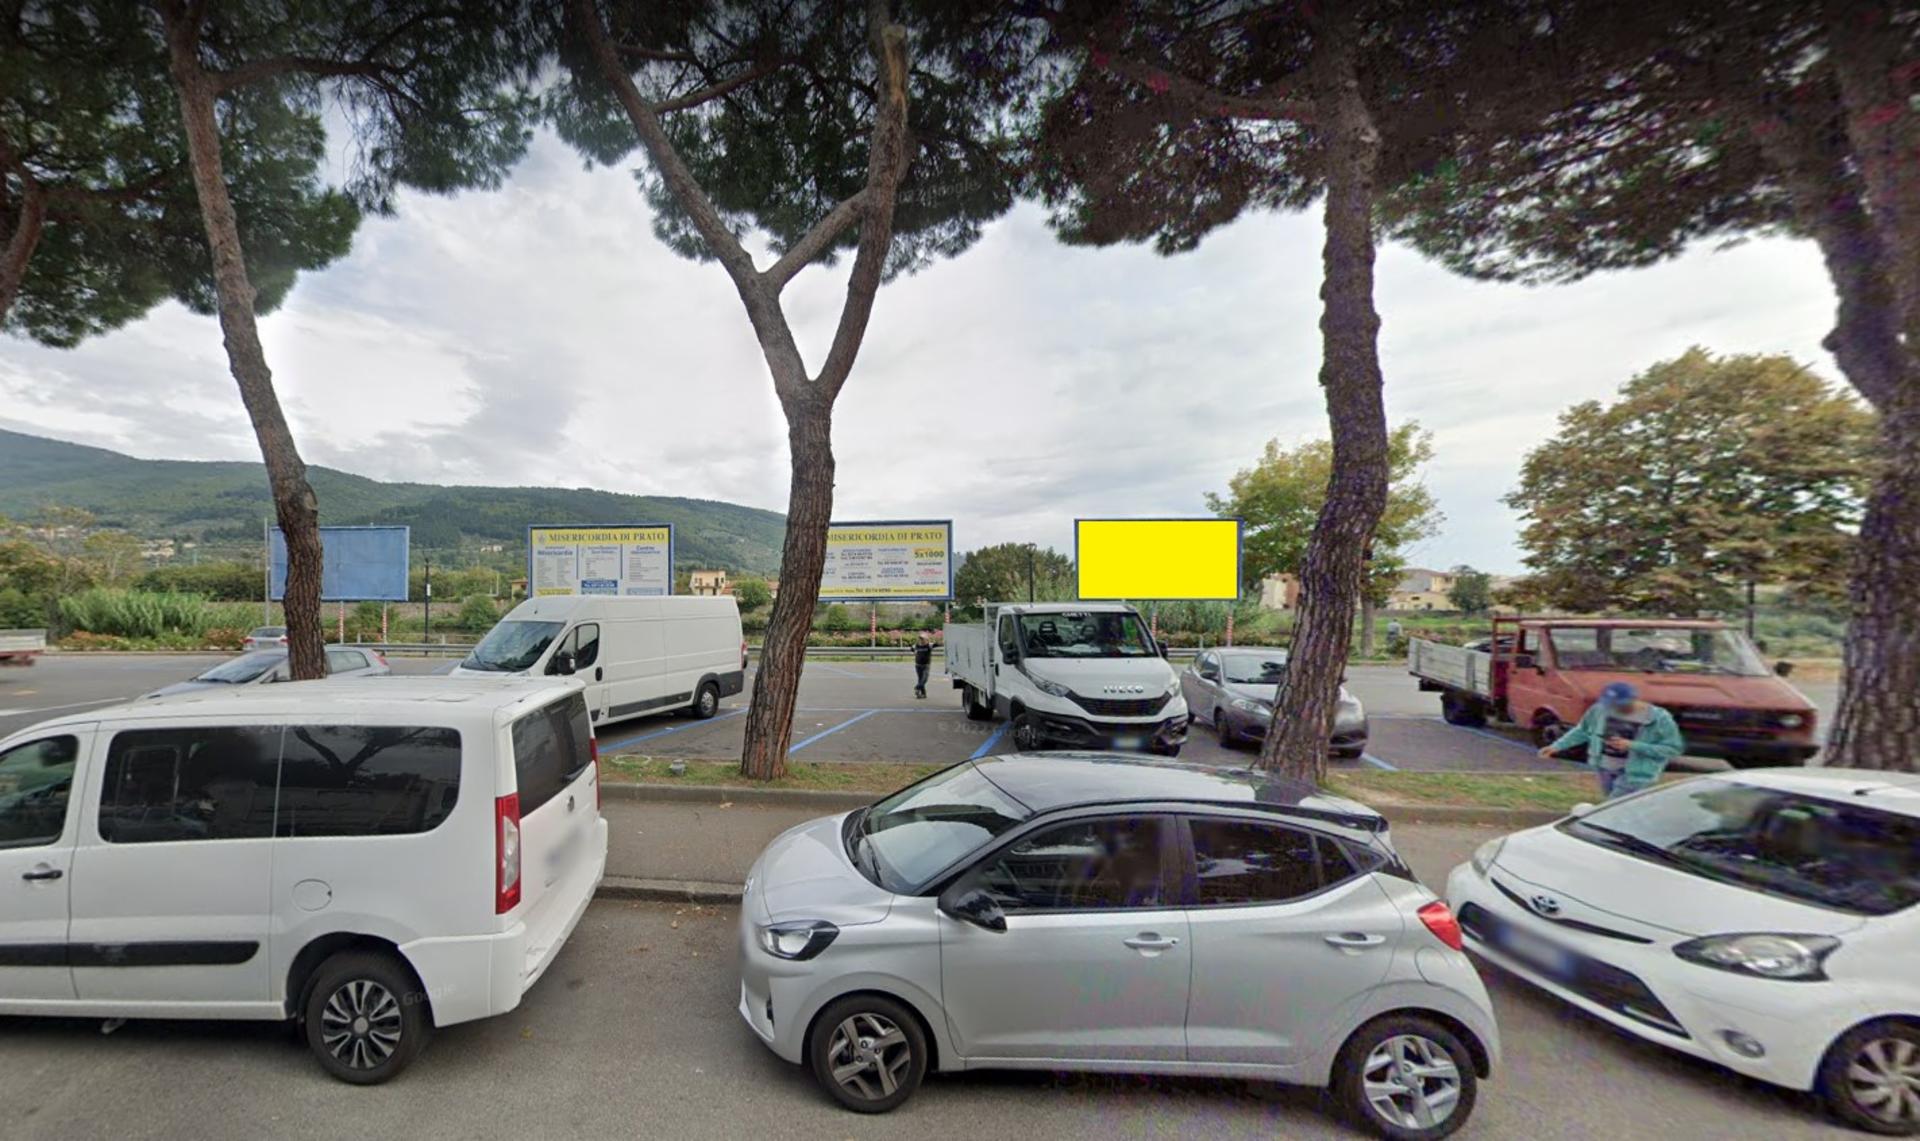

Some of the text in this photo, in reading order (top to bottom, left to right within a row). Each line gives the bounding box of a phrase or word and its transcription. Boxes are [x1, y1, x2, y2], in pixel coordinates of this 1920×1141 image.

[549, 532, 665, 542] MISERICORDIA DI PRATO
[897, 533, 908, 541] DI
[910, 532, 943, 541] PRATO
[914, 550, 945, 558] 5x1000
[1104, 685, 1143, 694] IVECO
